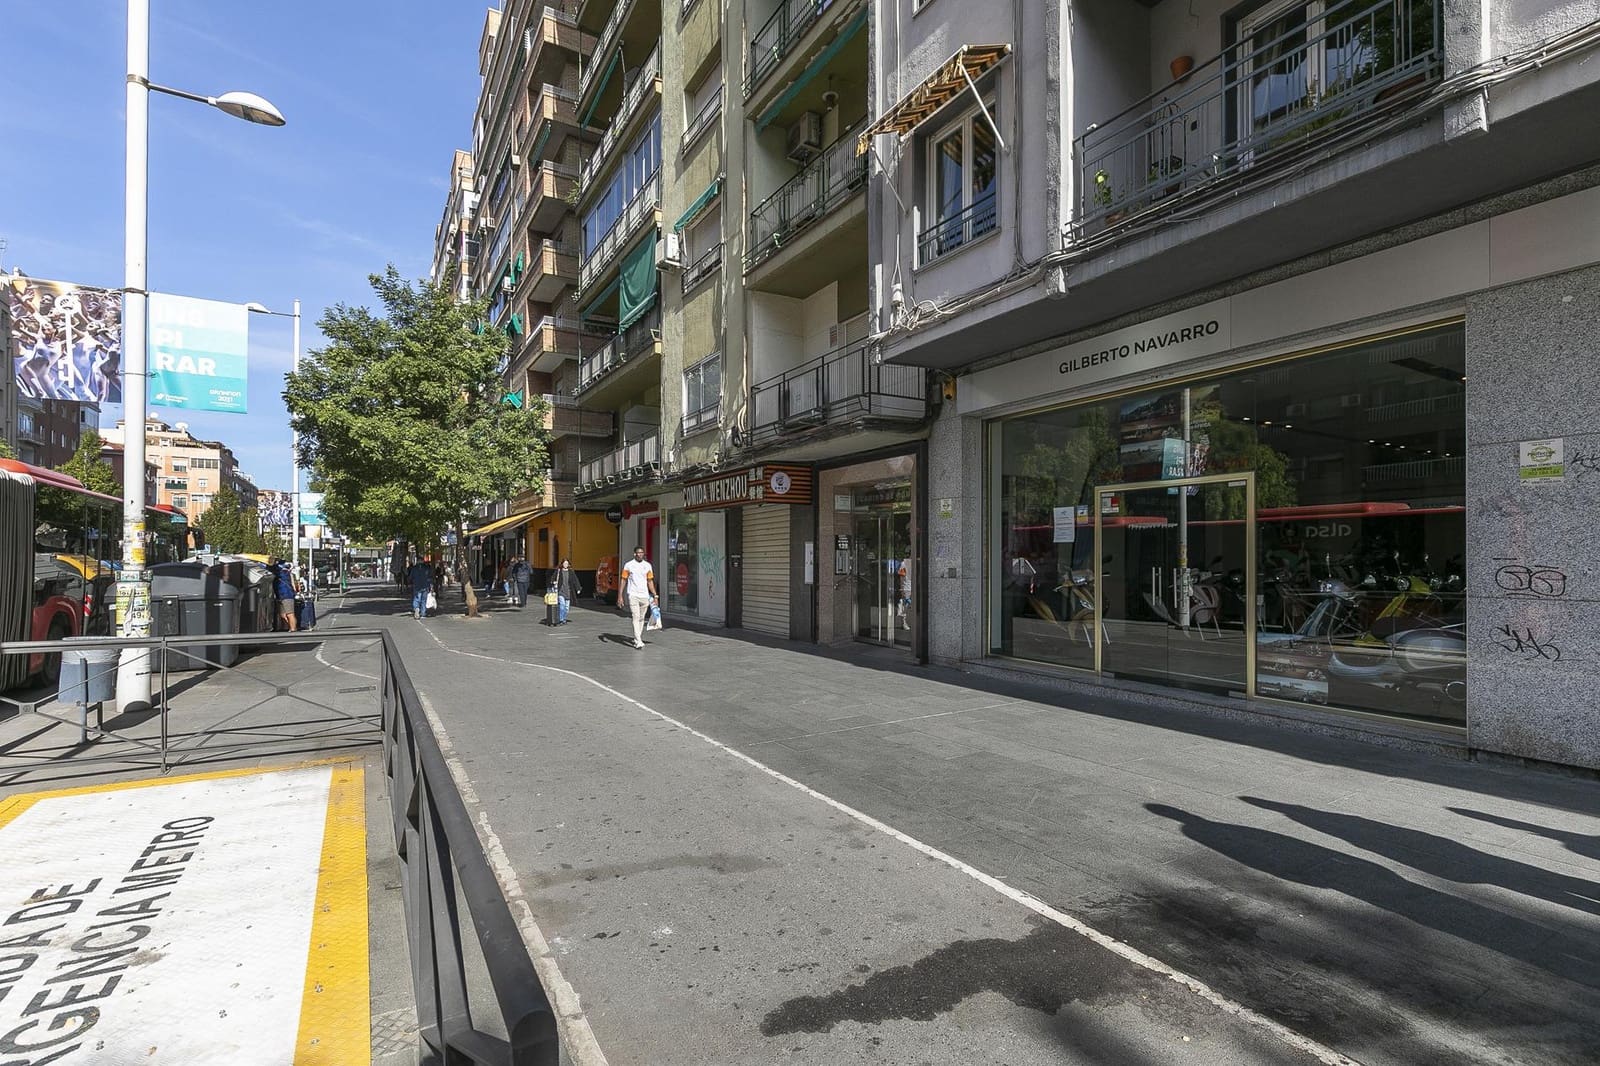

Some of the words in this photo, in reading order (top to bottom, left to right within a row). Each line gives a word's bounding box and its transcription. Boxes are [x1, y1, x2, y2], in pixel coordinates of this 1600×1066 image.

[156, 351, 217, 377] RAR
[1059, 345, 1130, 374] GILBERTO
[1134, 320, 1219, 354] NAVARRO
[682, 483, 708, 507] COMIDA
[709, 474, 747, 502] WENZHOU
[112, 816, 215, 895] METRO
[2, 877, 103, 926] DE
